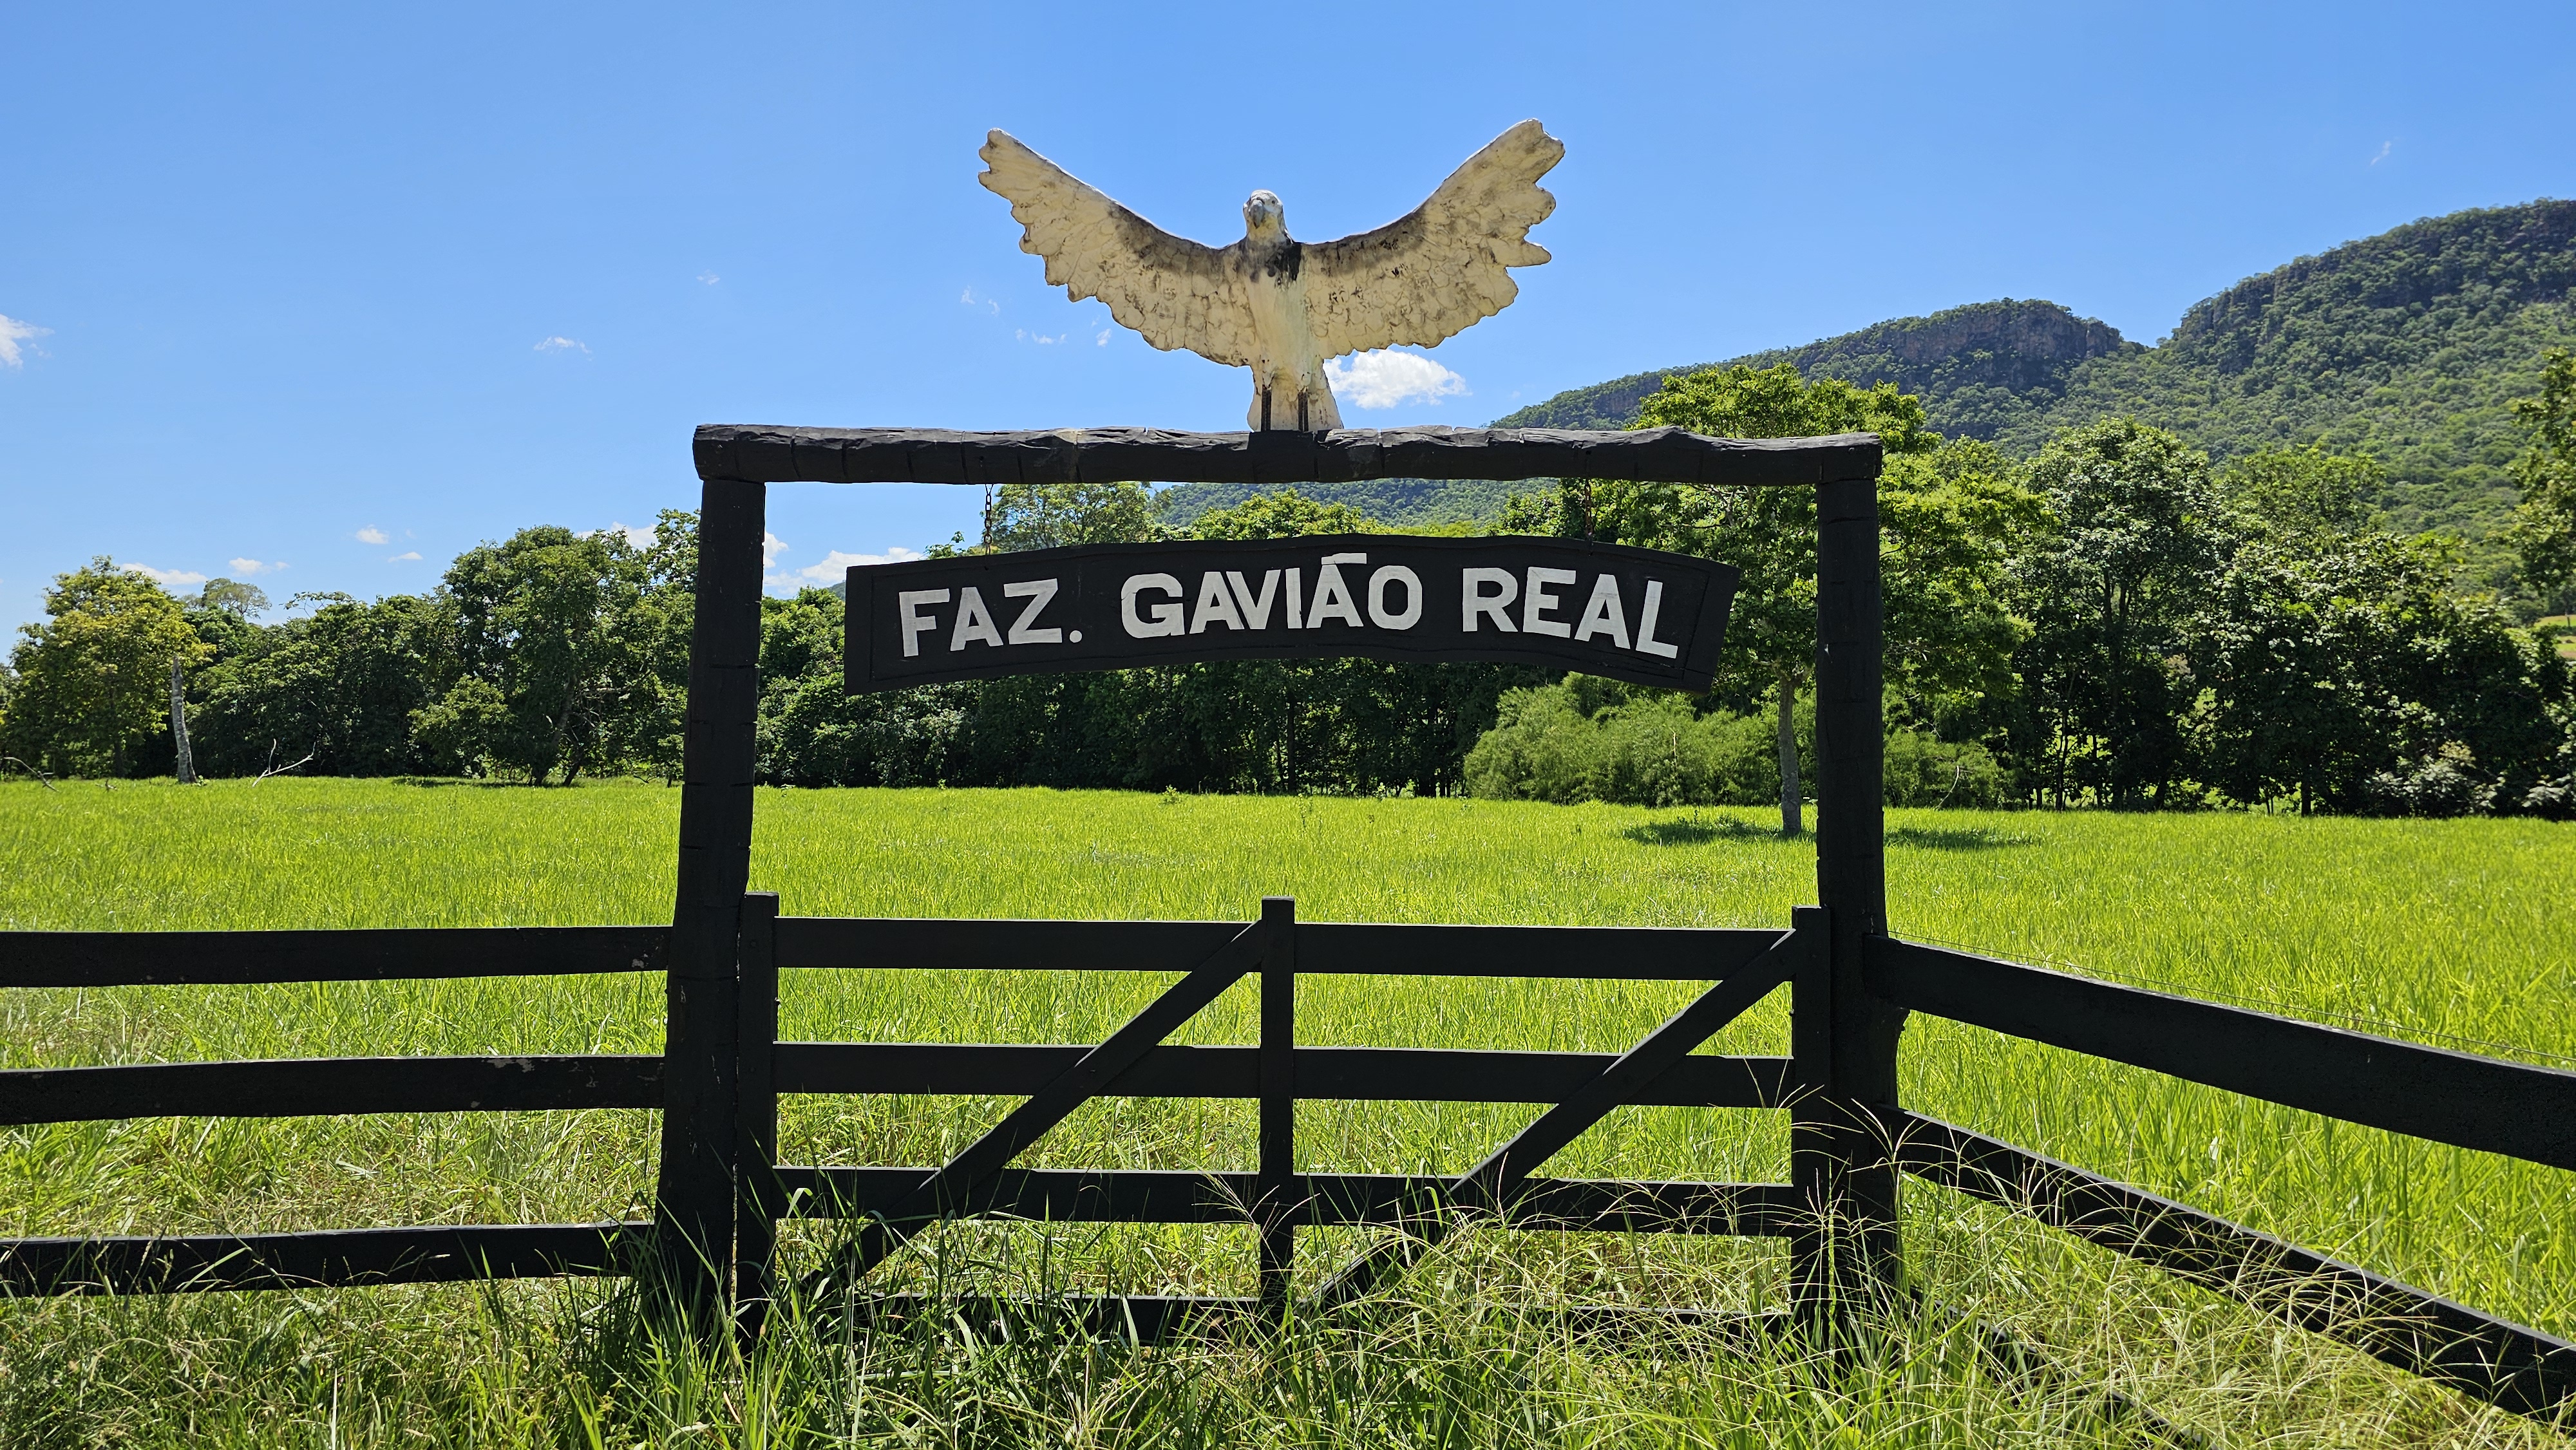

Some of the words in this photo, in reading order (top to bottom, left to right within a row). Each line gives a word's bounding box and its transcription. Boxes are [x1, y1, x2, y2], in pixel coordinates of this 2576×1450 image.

[899, 578, 1083, 657] FAZ.
[1121, 553, 1423, 639] GAVIÃO
[1463, 567, 1678, 659] REAL
